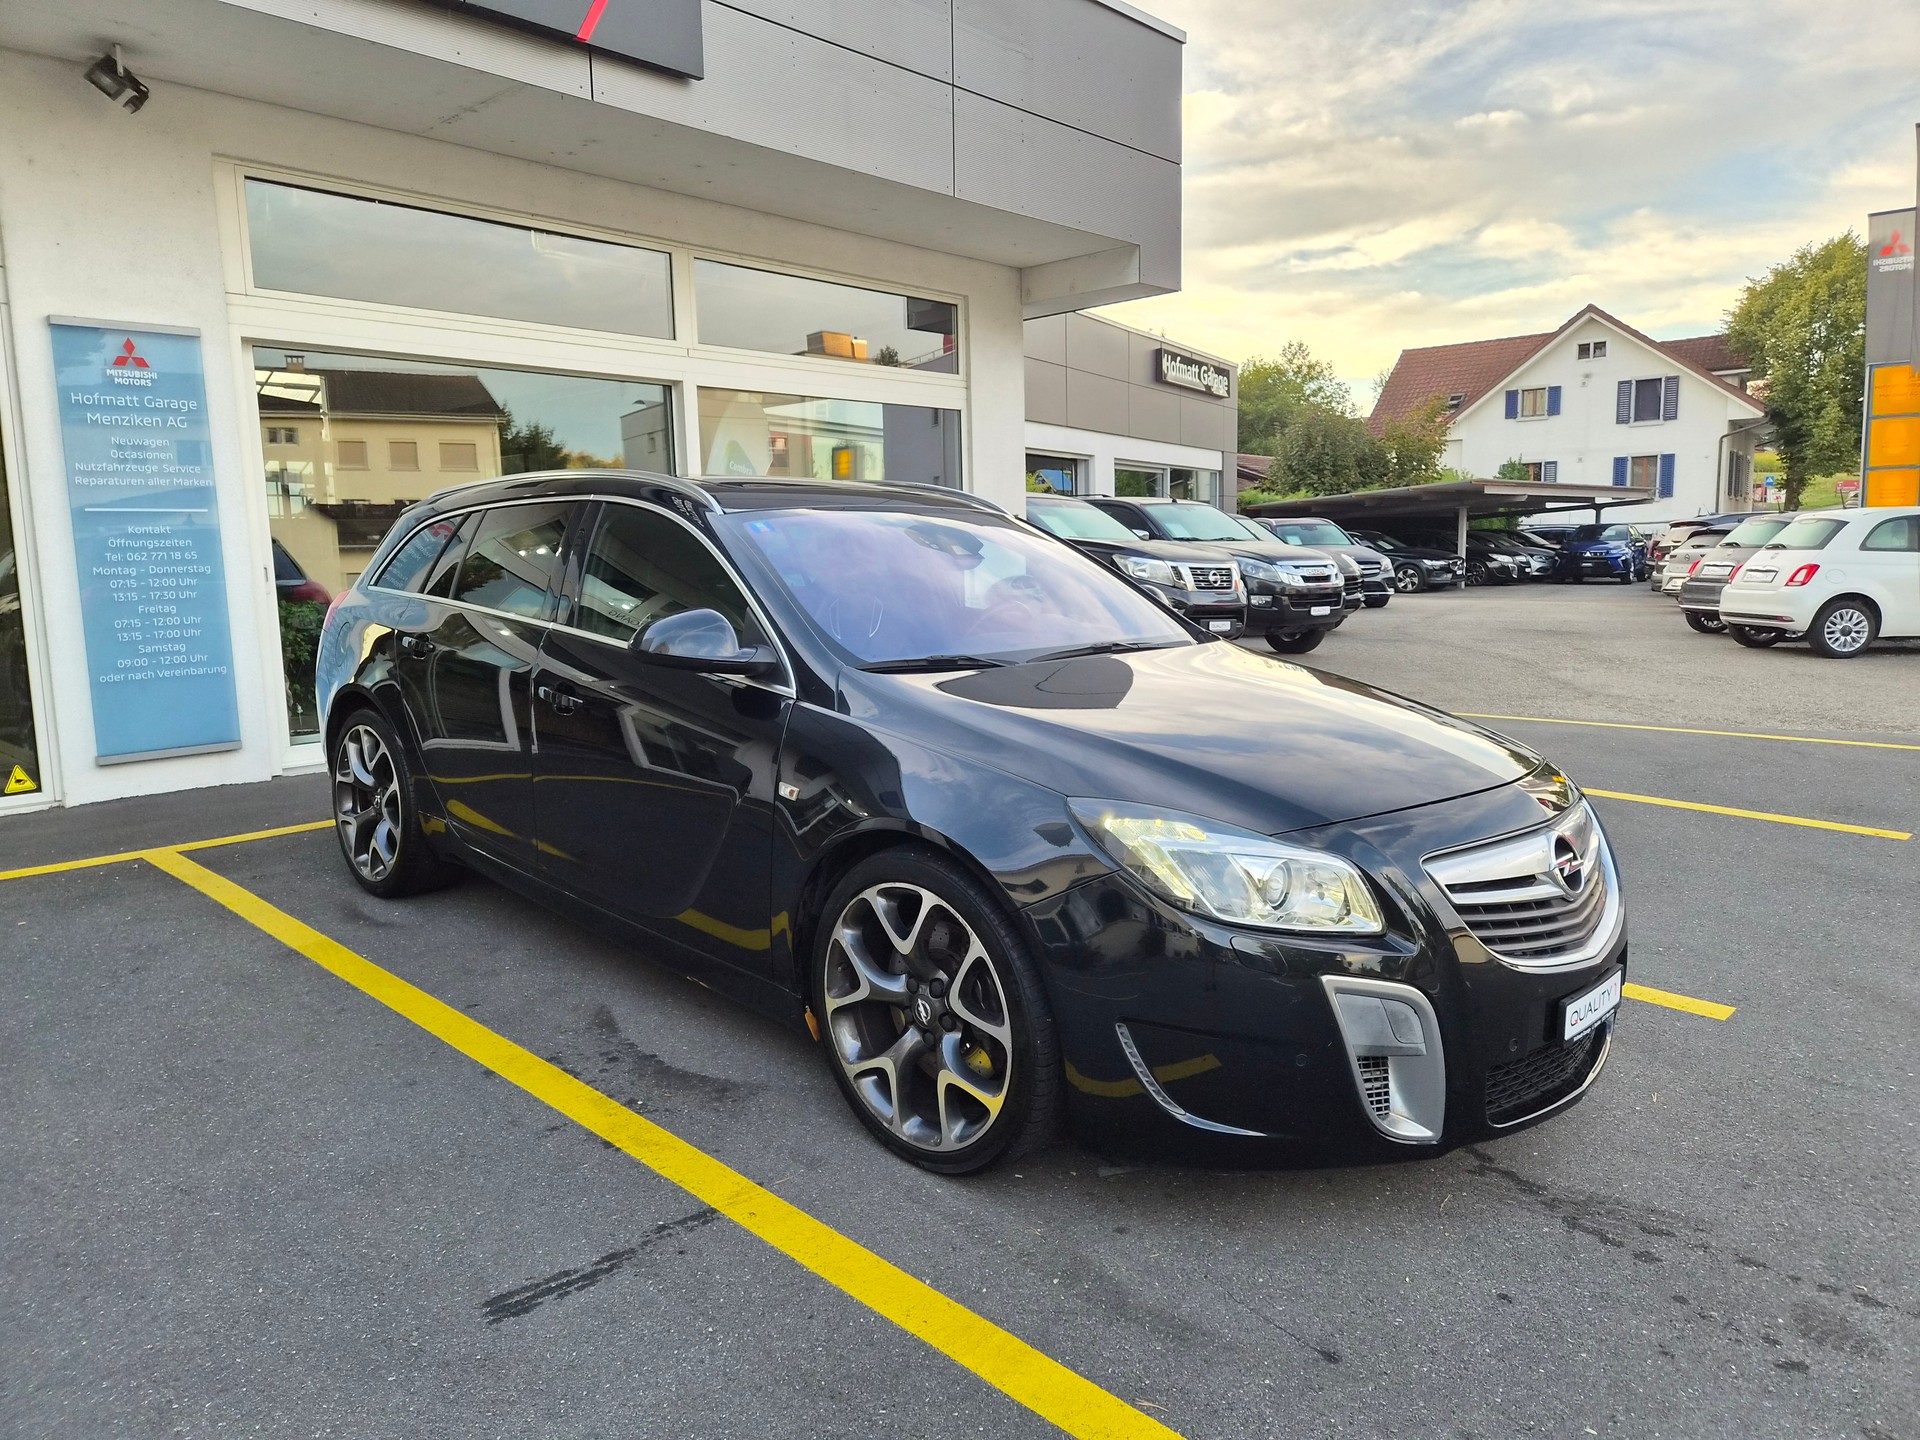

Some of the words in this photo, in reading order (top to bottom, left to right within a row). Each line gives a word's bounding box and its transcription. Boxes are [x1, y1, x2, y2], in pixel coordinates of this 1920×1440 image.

[106, 368, 158, 380] MITSUBISHI
[1163, 353, 1200, 383] Hofmatt
[1200, 365, 1229, 391] Garage
[114, 377, 152, 387] MOTORS
[70, 392, 140, 408] Hofmatt
[144, 396, 198, 412] Garage
[87, 412, 162, 428] Menziken
[166, 416, 188, 429] AG
[111, 436, 170, 448] Neuwagen
[110, 450, 174, 460] Occasionen
[75, 462, 159, 473] Nutzfahrzeuge
[162, 464, 201, 474] Service
[74, 476, 145, 487] Reparaturen
[147, 477, 171, 486] aller
[173, 477, 213, 487] Marken
[127, 525, 172, 535] Kontakt
[108, 536, 193, 549] Öffnungszeiten
[105, 552, 124, 562] Tel:
[126, 552, 148, 561] 062
[151, 551, 168, 561] 771
[170, 551, 182, 560] 18
[184, 551, 198, 560] 65
[92, 566, 137, 577] Montag
[149, 565, 212, 575] Donnerstag
[109, 579, 137, 589] 07:15
[148, 578, 177, 588] 12:00
[179, 577, 198, 586] Uhr
[112, 592, 138, 602] 13:15
[149, 591, 176, 600] 17:30
[178, 590, 198, 599] Uhr
[138, 604, 177, 614] Freitag
[114, 619, 142, 628] 07:15
[152, 617, 181, 627] 12:00
[183, 616, 202, 625] Uhr
[117, 632, 143, 642] 13:15
[153, 630, 181, 640] 17:00
[183, 629, 202, 638] Uhr
[138, 643, 187, 654] Samstag
[117, 658, 149, 668] 09:00
[159, 655, 187, 666] 12:00
[189, 654, 209, 663] Uhr
[99, 672, 126, 683] oder
[128, 671, 155, 681] nach
[157, 664, 228, 679] Vereinbarung
[1570, 985, 1613, 1027] QUALITY
